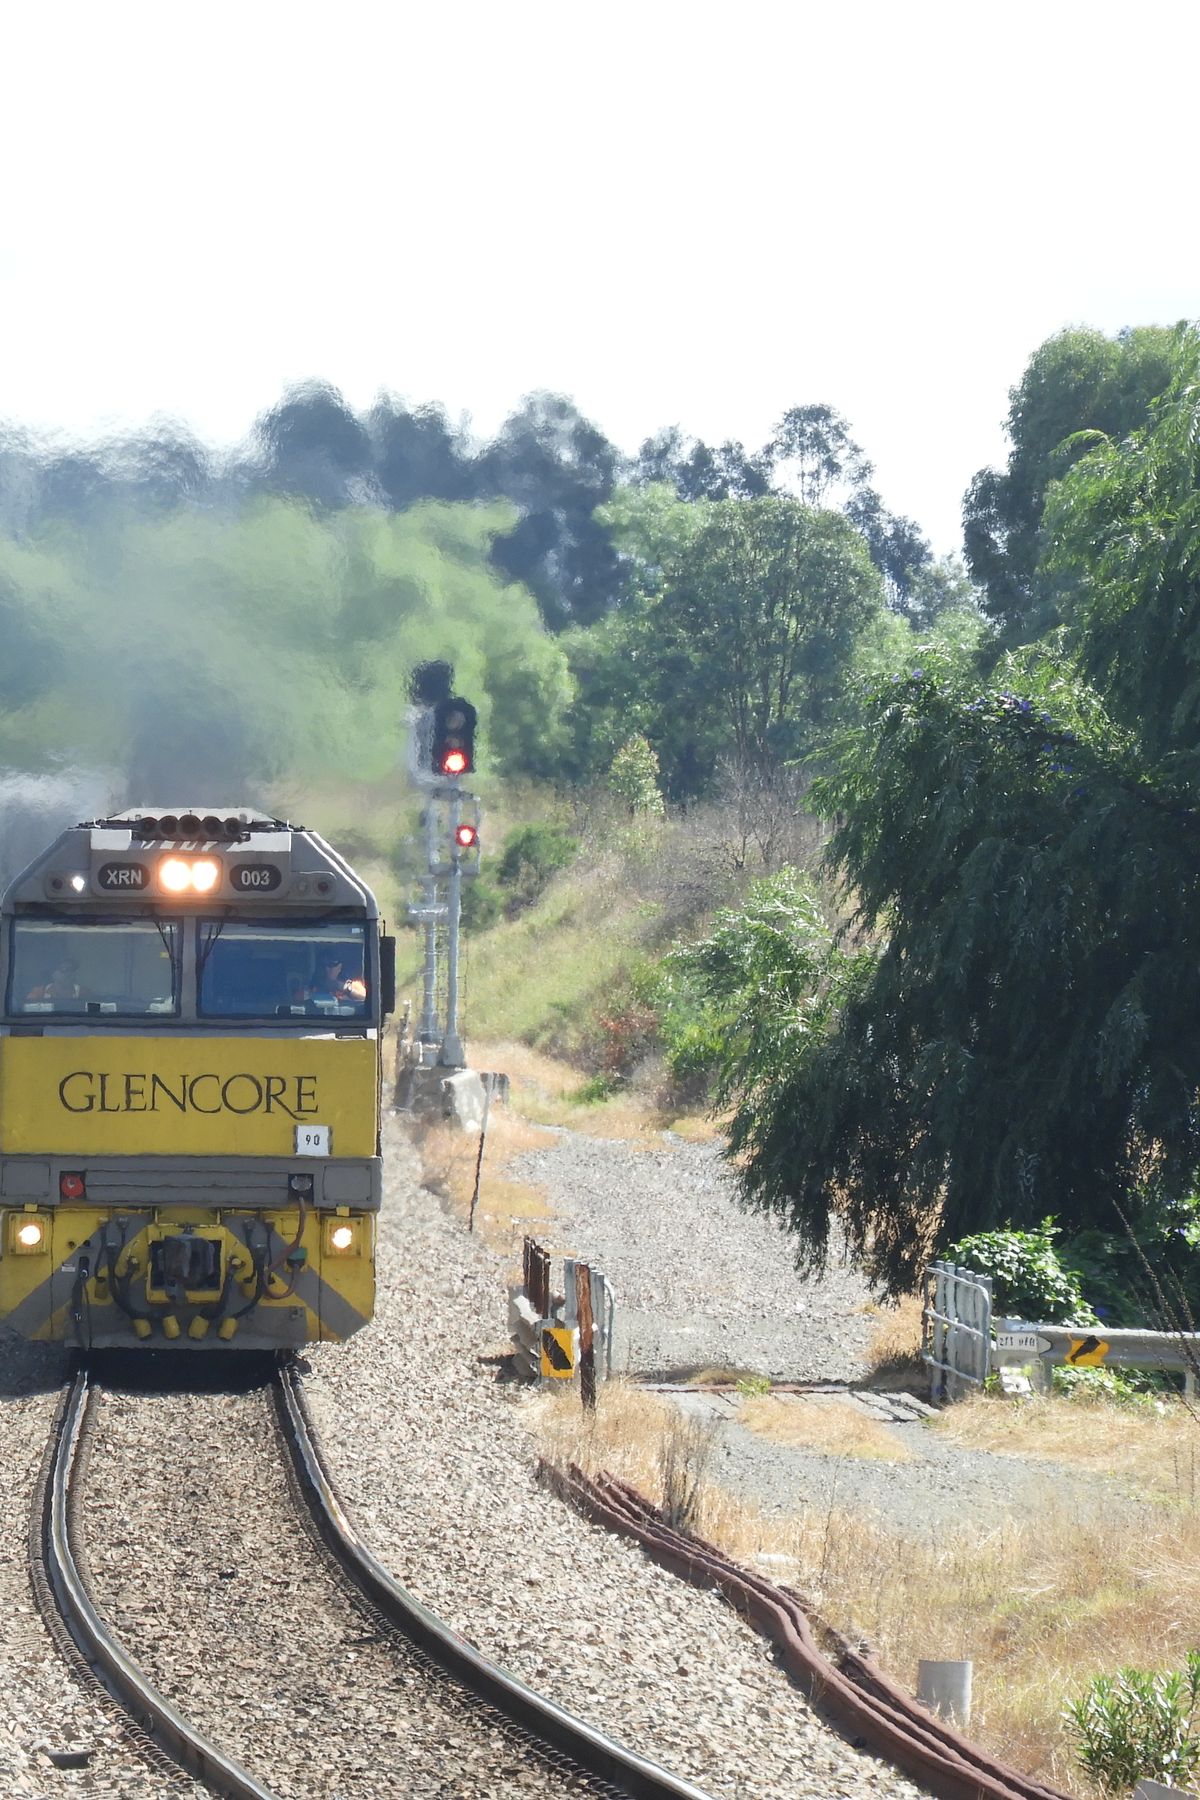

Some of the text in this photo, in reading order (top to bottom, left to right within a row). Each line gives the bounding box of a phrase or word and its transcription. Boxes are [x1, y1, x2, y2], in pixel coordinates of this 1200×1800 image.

[107, 869, 142, 885] XRN
[241, 870, 270, 885] 003
[58, 1071, 319, 1120] GLENCORE
[305, 1134, 320, 1146] 90
